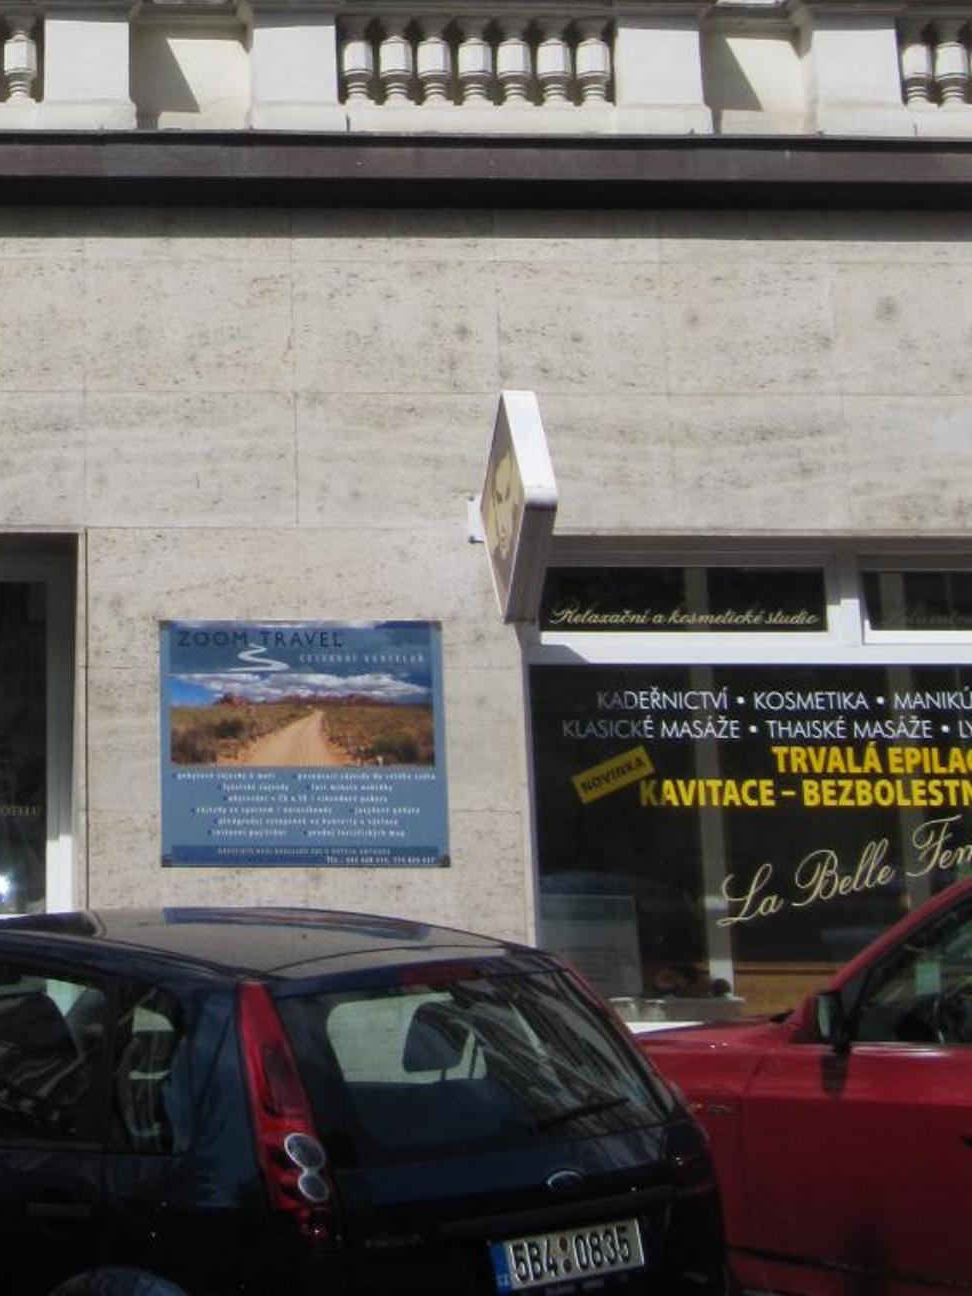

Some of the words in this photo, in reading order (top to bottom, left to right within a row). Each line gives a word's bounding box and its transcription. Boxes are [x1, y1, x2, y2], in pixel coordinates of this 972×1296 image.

[653, 614, 666, 624] a
[668, 605, 762, 625] kosmetické
[178, 631, 249, 648] ZOOM
[259, 631, 343, 648] TRAVEL
[598, 686, 728, 710] KADEŘNICTVÍ
[753, 691, 869, 710] KOSMETIKA
[563, 715, 654, 738] KLASICKÉ
[660, 715, 741, 739] MASÁŽE
[766, 715, 847, 739] THAISKÉ
[853, 715, 933, 739] MASÁŽE
[771, 740, 883, 774] TRVALÁ
[581, 756, 647, 792] NOVINKA
[640, 779, 776, 806] KAVITACE
[716, 863, 785, 927] La
[791, 837, 897, 907] Belle
[573, 1225, 632, 1271] 0835
